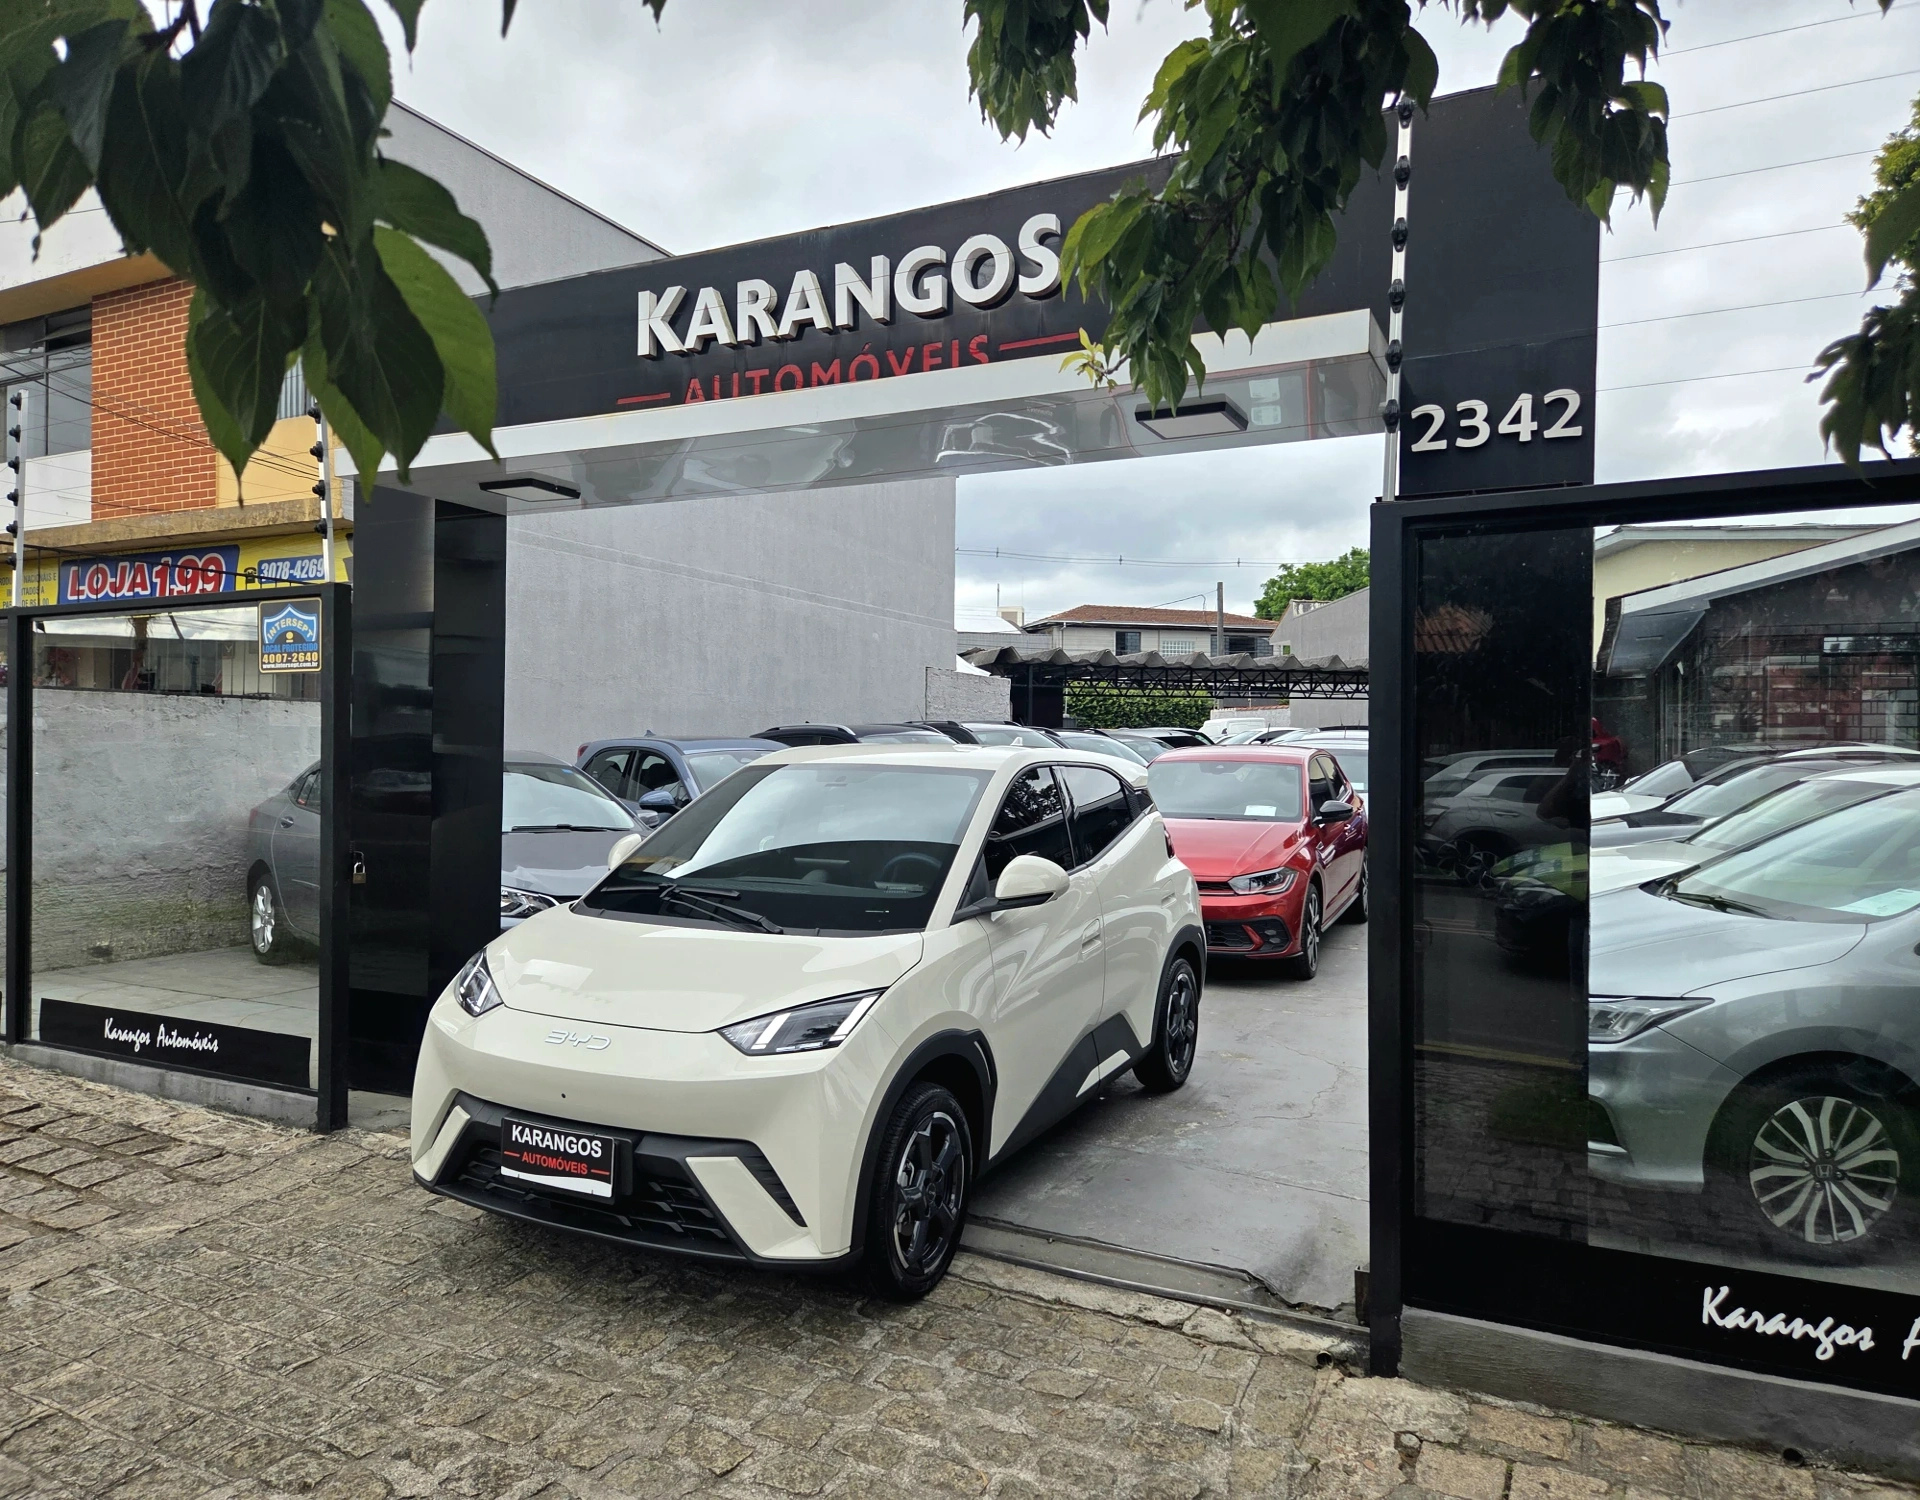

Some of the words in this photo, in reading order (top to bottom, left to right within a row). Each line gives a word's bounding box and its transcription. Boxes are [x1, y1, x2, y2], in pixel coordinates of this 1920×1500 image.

[637, 213, 1062, 358] KARANGOS
[1411, 388, 1583, 452] 2342
[67, 561, 151, 600] LOJA
[261, 558, 324, 582] 3078-4269
[267, 618, 313, 639] INTERSEPT
[263, 645, 281, 653] LOCAL
[282, 643, 318, 652] PROTEGIDO
[263, 652, 318, 663] 4007-2640
[104, 1017, 151, 1053] Karangos
[156, 1023, 219, 1053] Automóveis
[544, 1029, 612, 1050] BYD
[511, 1124, 602, 1158] KARANGOS
[521, 1151, 588, 1175] AUTOMÓVEIS
[1702, 1285, 1875, 1361] Karangos
